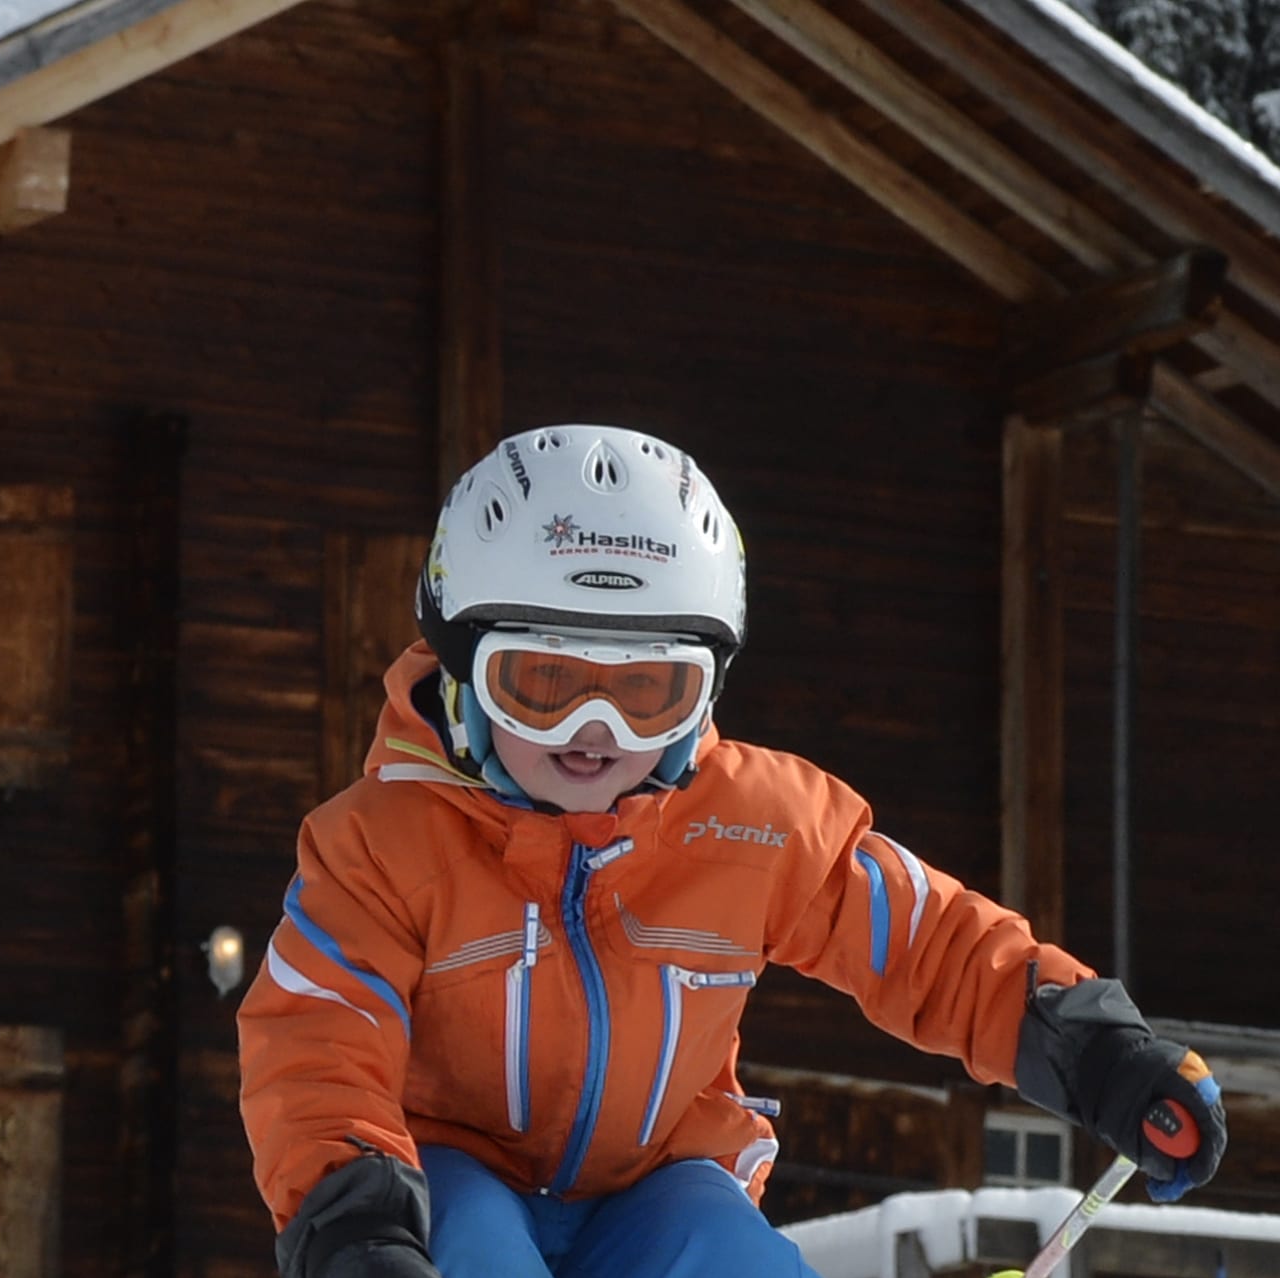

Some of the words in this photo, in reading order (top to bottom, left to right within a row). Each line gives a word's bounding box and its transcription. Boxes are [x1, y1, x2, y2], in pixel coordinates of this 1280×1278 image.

[578, 531, 677, 558] Haslital
[604, 548, 669, 563] OBERLAND
[575, 574, 639, 588] ALPINA
[683, 815, 789, 849] phenix
